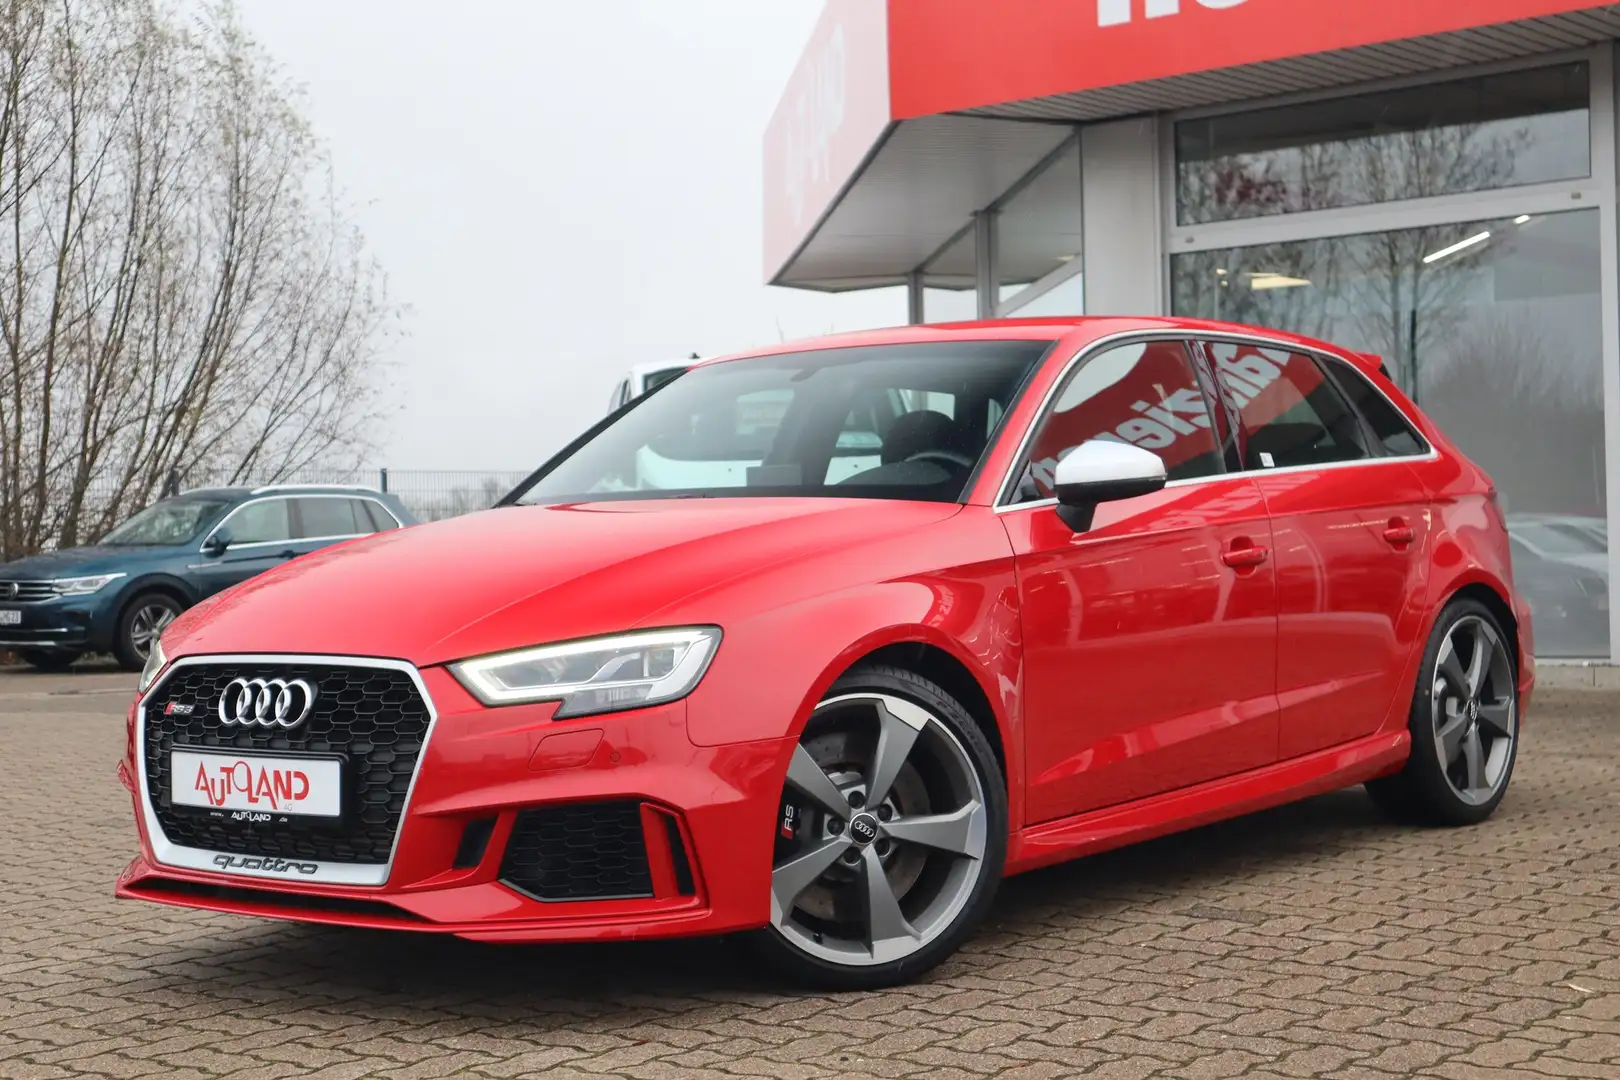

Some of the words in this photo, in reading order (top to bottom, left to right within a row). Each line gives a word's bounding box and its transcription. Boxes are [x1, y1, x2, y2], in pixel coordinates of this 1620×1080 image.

[283, 803, 293, 812] AG
[784, 804, 794, 832] RS
[212, 854, 318, 875] quattro
